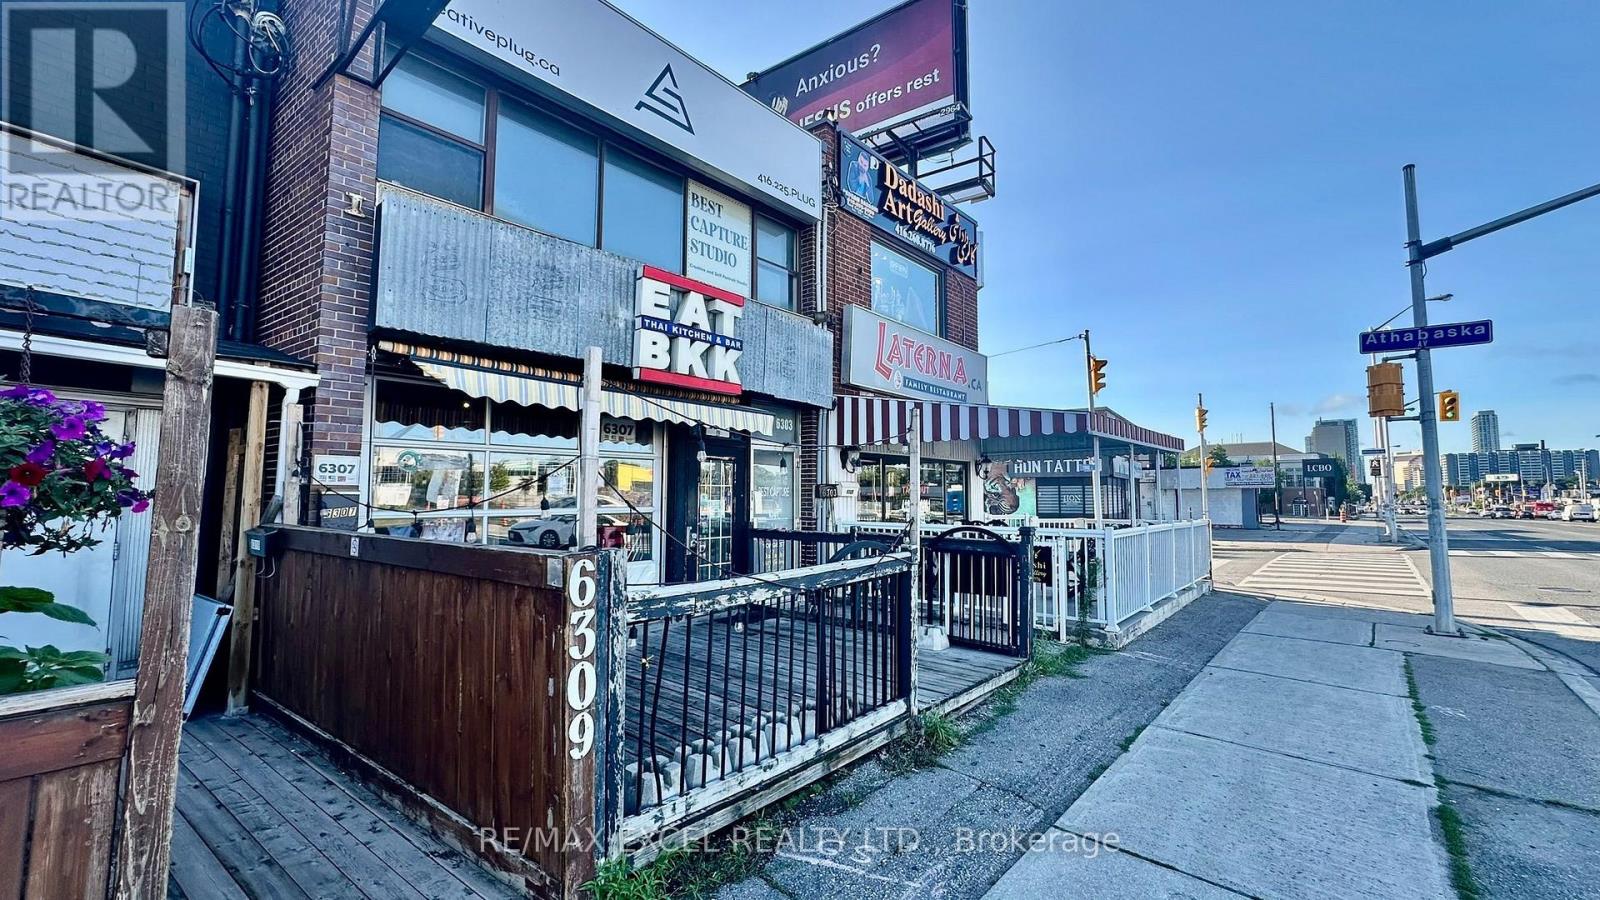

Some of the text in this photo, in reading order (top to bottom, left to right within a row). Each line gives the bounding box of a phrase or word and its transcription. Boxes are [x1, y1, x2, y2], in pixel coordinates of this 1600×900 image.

[795, 43, 882, 97] Anxious?
[856, 85, 903, 113] offers
[906, 67, 940, 94] rest
[690, 191, 724, 218] BEST
[757, 173, 816, 208] 416.225.PLUG
[884, 161, 945, 221] Dadashi
[883, 189, 913, 224] Art
[690, 215, 748, 251] CAPTURE
[690, 239, 737, 268] STUDIO
[636, 276, 742, 338] EAT
[644, 319, 741, 349] THAI KITCHEN & BAR
[1366, 324, 1486, 345] Athabaska
[634, 329, 742, 385] BKK
[874, 320, 968, 386] LATERNA
[905, 379, 966, 400] FAMILY RESTAURANT
[603, 423, 634, 436] 6307
[775, 418, 793, 431] 6303
[318, 463, 356, 474] 6307
[1044, 458, 1102, 473] TATT
[1226, 471, 1241, 479] TAX
[1307, 463, 1332, 473] LCBO
[567, 558, 598, 760] 6309
